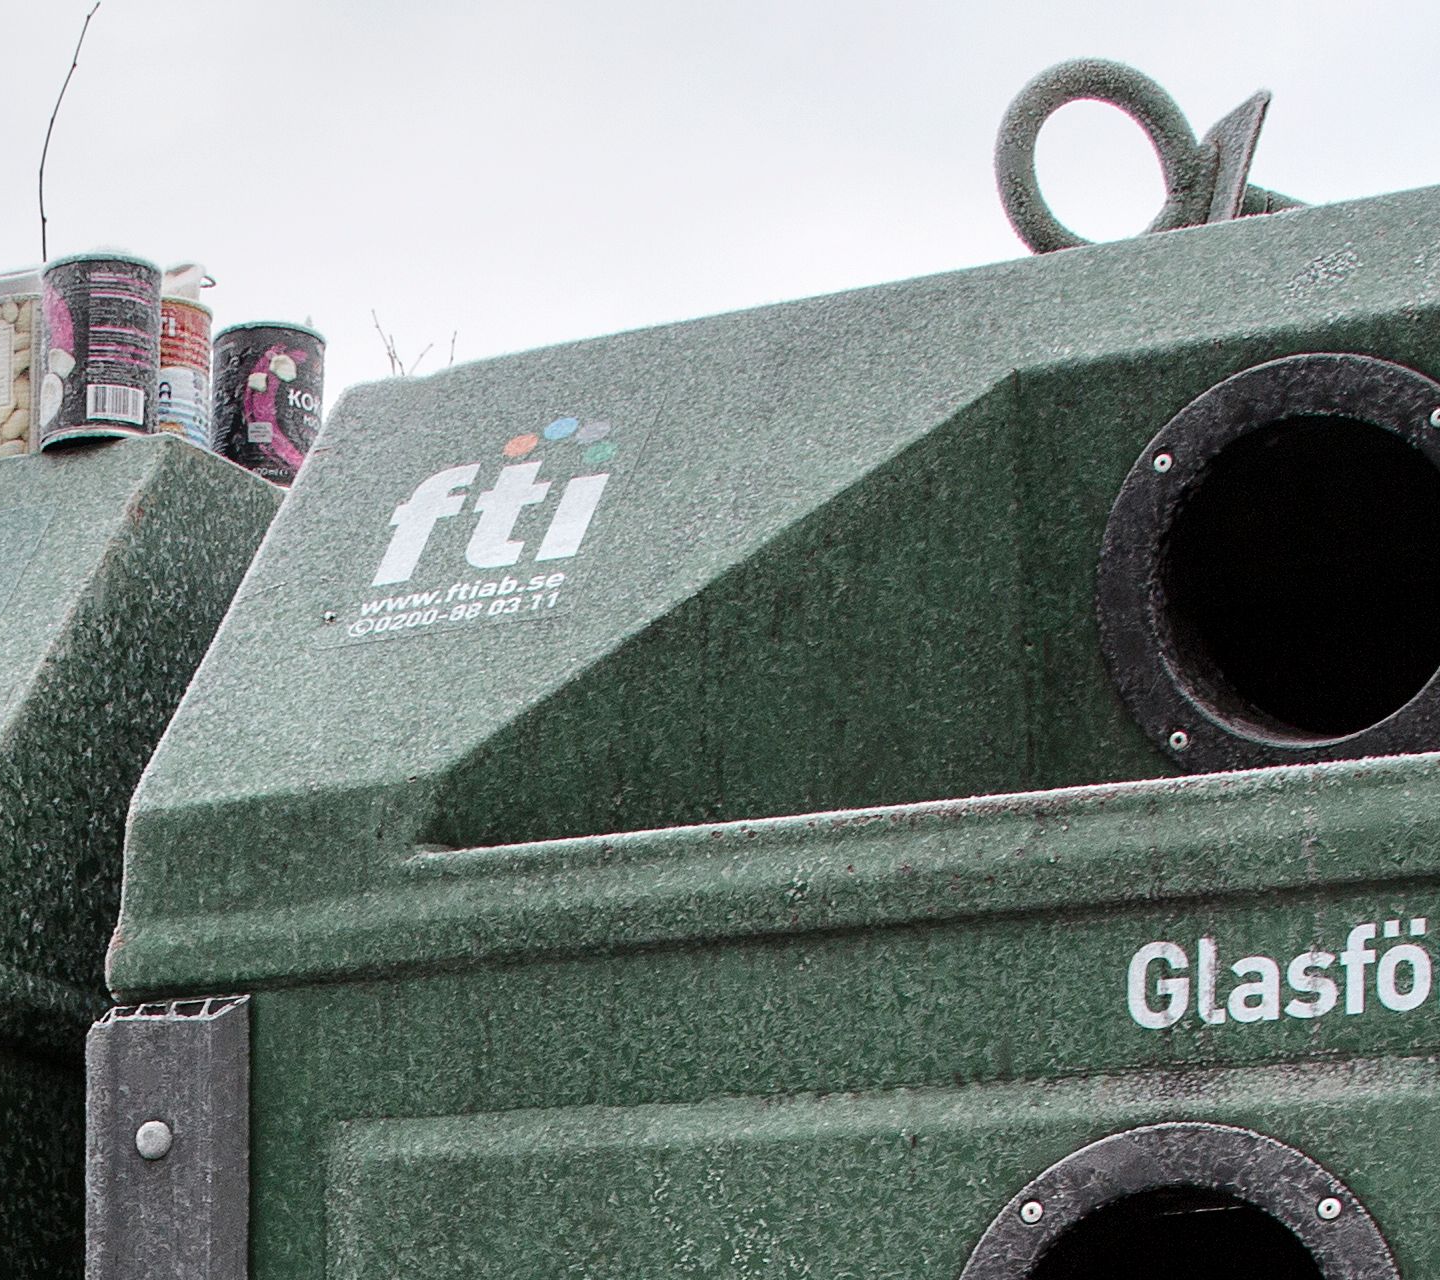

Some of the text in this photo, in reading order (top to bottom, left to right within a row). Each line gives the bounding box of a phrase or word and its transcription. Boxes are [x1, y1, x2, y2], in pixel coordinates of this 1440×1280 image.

[371, 460, 610, 587] fti
[360, 572, 565, 617] www.ftiab.se
[485, 597, 516, 617] 03
